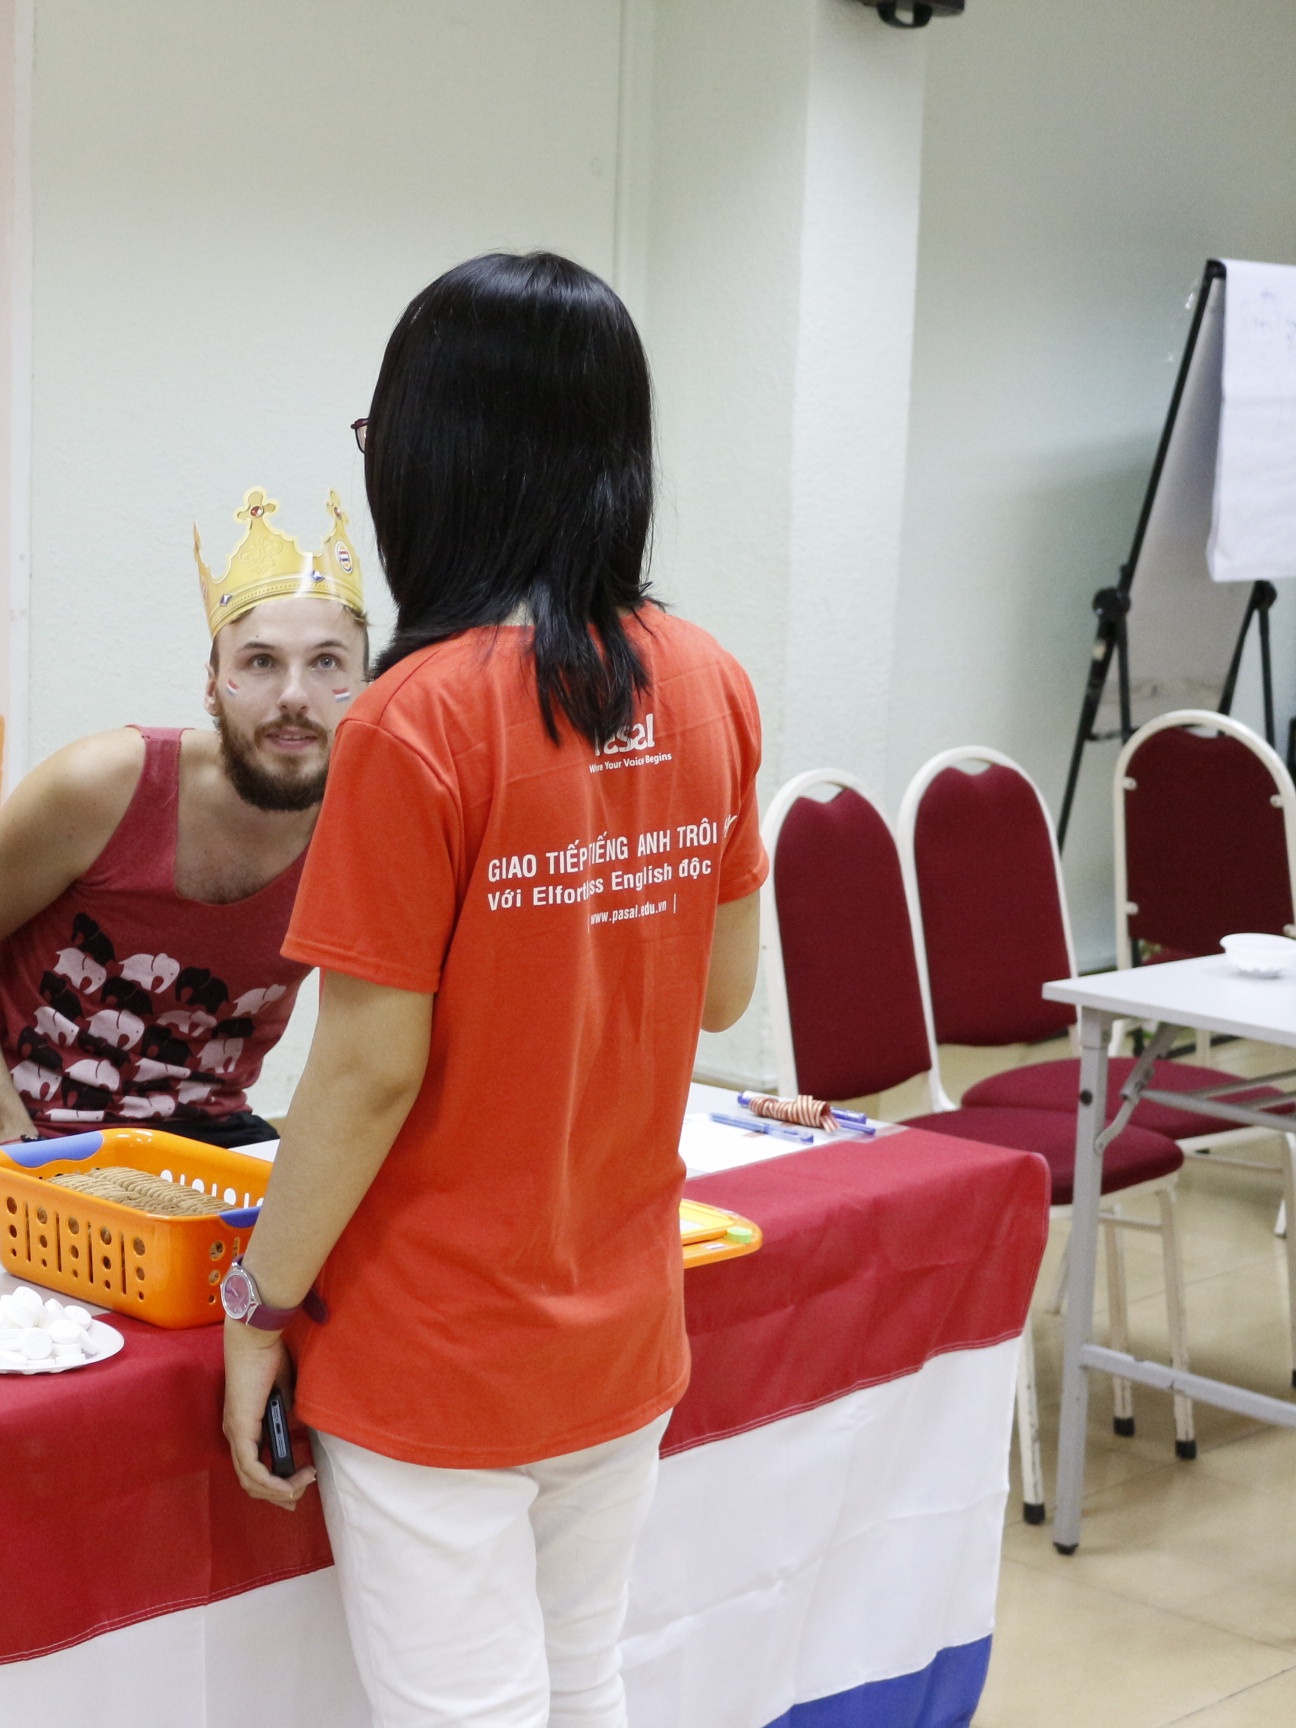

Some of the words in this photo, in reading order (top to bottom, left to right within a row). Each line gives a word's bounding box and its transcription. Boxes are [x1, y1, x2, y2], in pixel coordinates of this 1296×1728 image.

[604, 760, 622, 770] Your
[623, 757, 645, 768] Voice
[645, 753, 672, 765] Begins
[488, 854, 537, 883] GIAO
[546, 839, 588, 875] TIẾP
[637, 829, 671, 857] ANH
[677, 818, 718, 849] TRÔI
[487, 888, 521, 911] Với
[611, 863, 673, 892] English
[678, 857, 712, 880] độc
[590, 899, 667, 925] www.pasal.edu.vn
